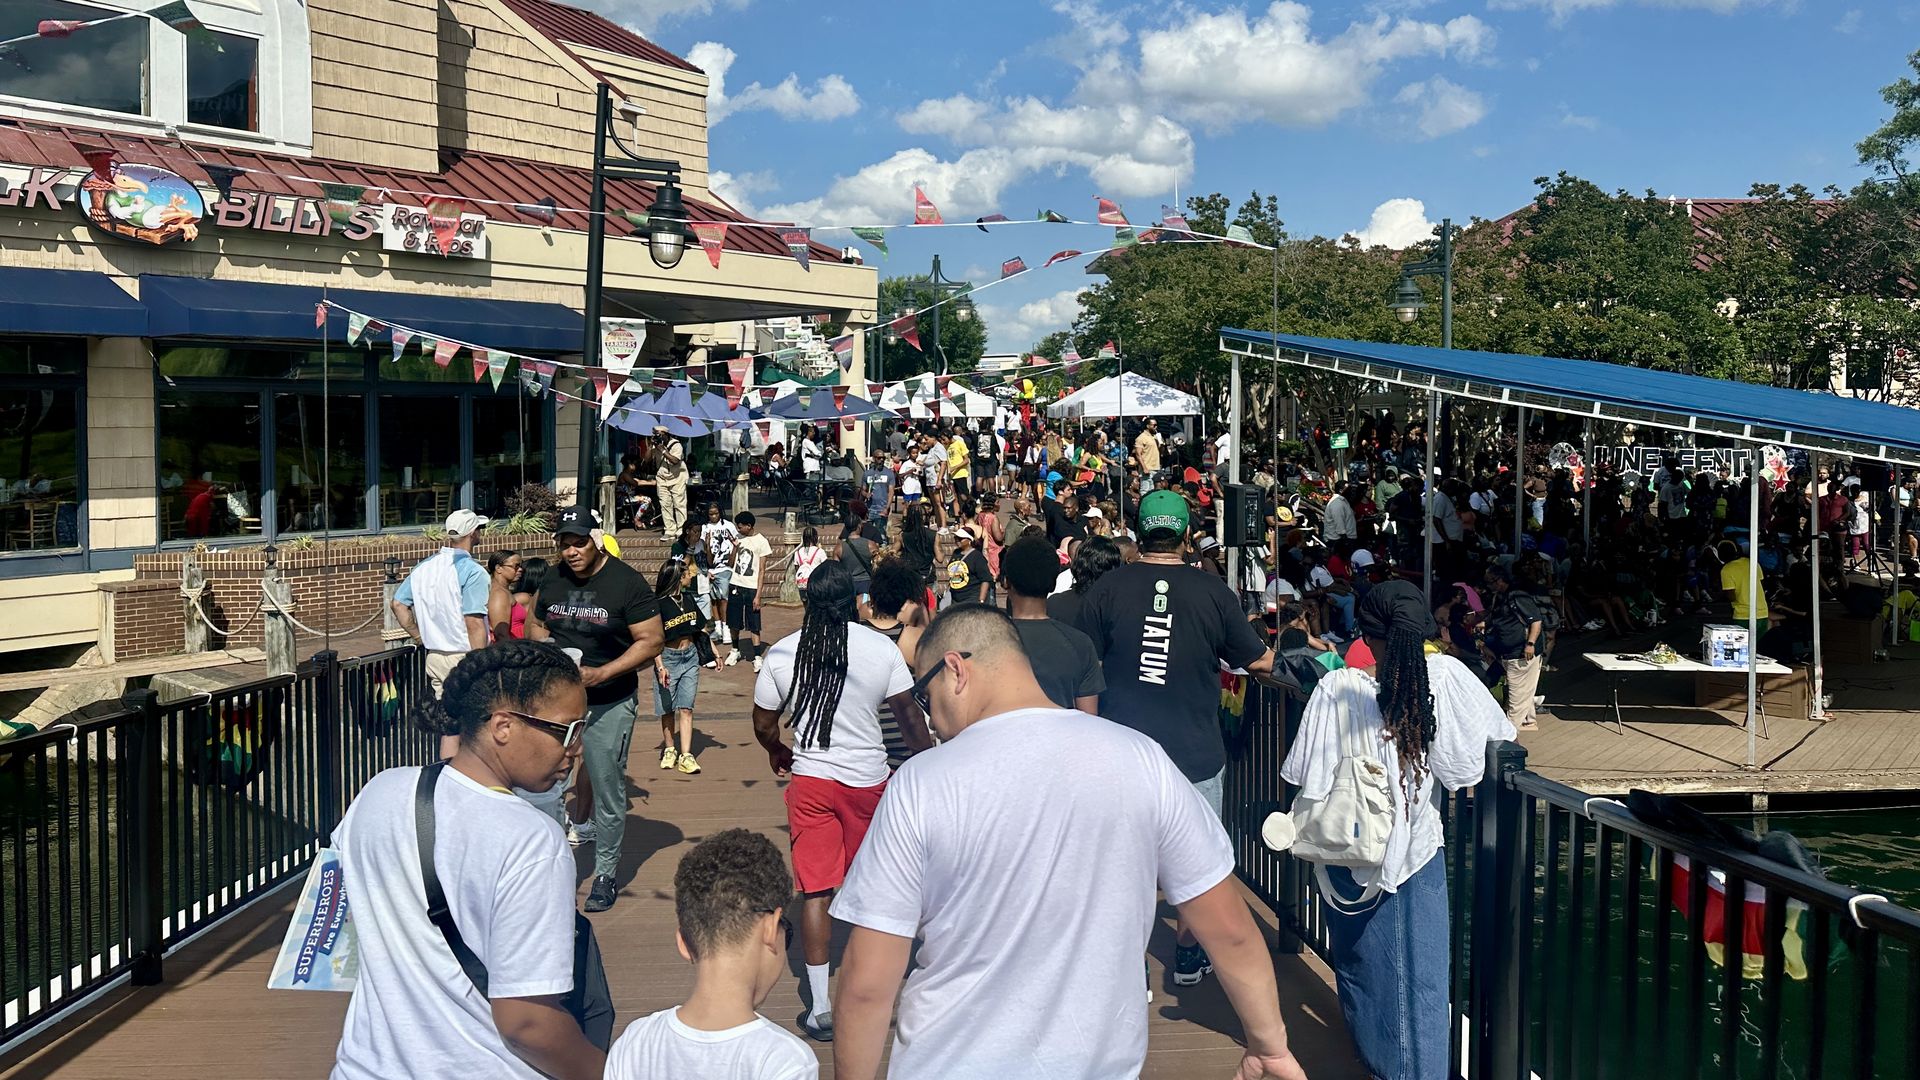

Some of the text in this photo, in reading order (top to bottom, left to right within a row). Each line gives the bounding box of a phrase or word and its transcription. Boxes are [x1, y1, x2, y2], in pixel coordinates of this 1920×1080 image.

[214, 190, 376, 241] BILLYS
[460, 218, 485, 234] ar
[403, 230, 473, 254] & Rbs
[1142, 514, 1182, 530] CELTICS
[1138, 614, 1173, 685] TATUM
[297, 869, 335, 975] SUPERHEROES
[323, 879, 347, 950] Are Everywh
